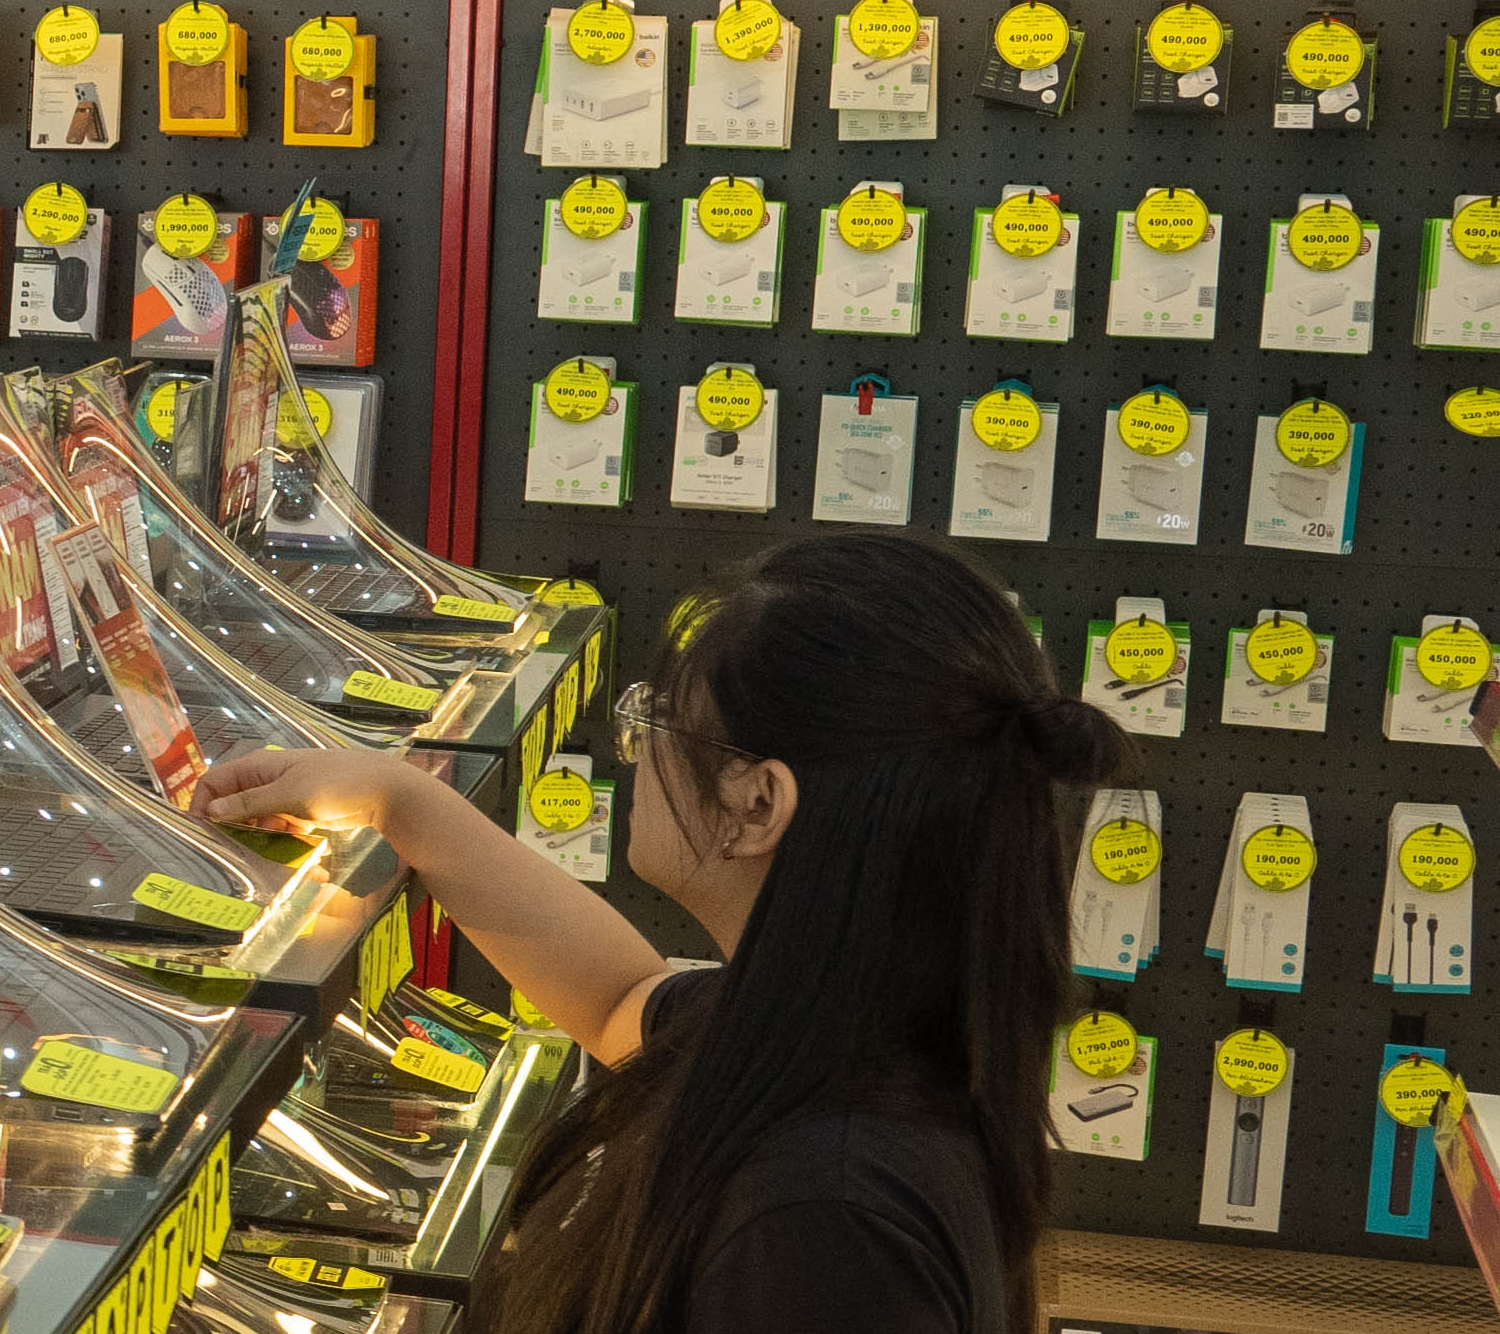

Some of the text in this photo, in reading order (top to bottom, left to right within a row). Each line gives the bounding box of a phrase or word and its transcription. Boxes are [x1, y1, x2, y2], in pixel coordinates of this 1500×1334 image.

[573, 28, 626, 41] 2,700,000
[858, 23, 912, 34] 1,390,000
[178, 31, 218, 41] 680,000
[32, 208, 80, 224] 2,290,000
[711, 206, 753, 218] 490,000
[1147, 217, 1193, 228] 490,000
[1258, 645, 1304, 659] 450,000
[539, 796, 581, 810] 417,000
[1255, 854, 1302, 866] 190,000
[1076, 1038, 1131, 1056] 1,790,000
